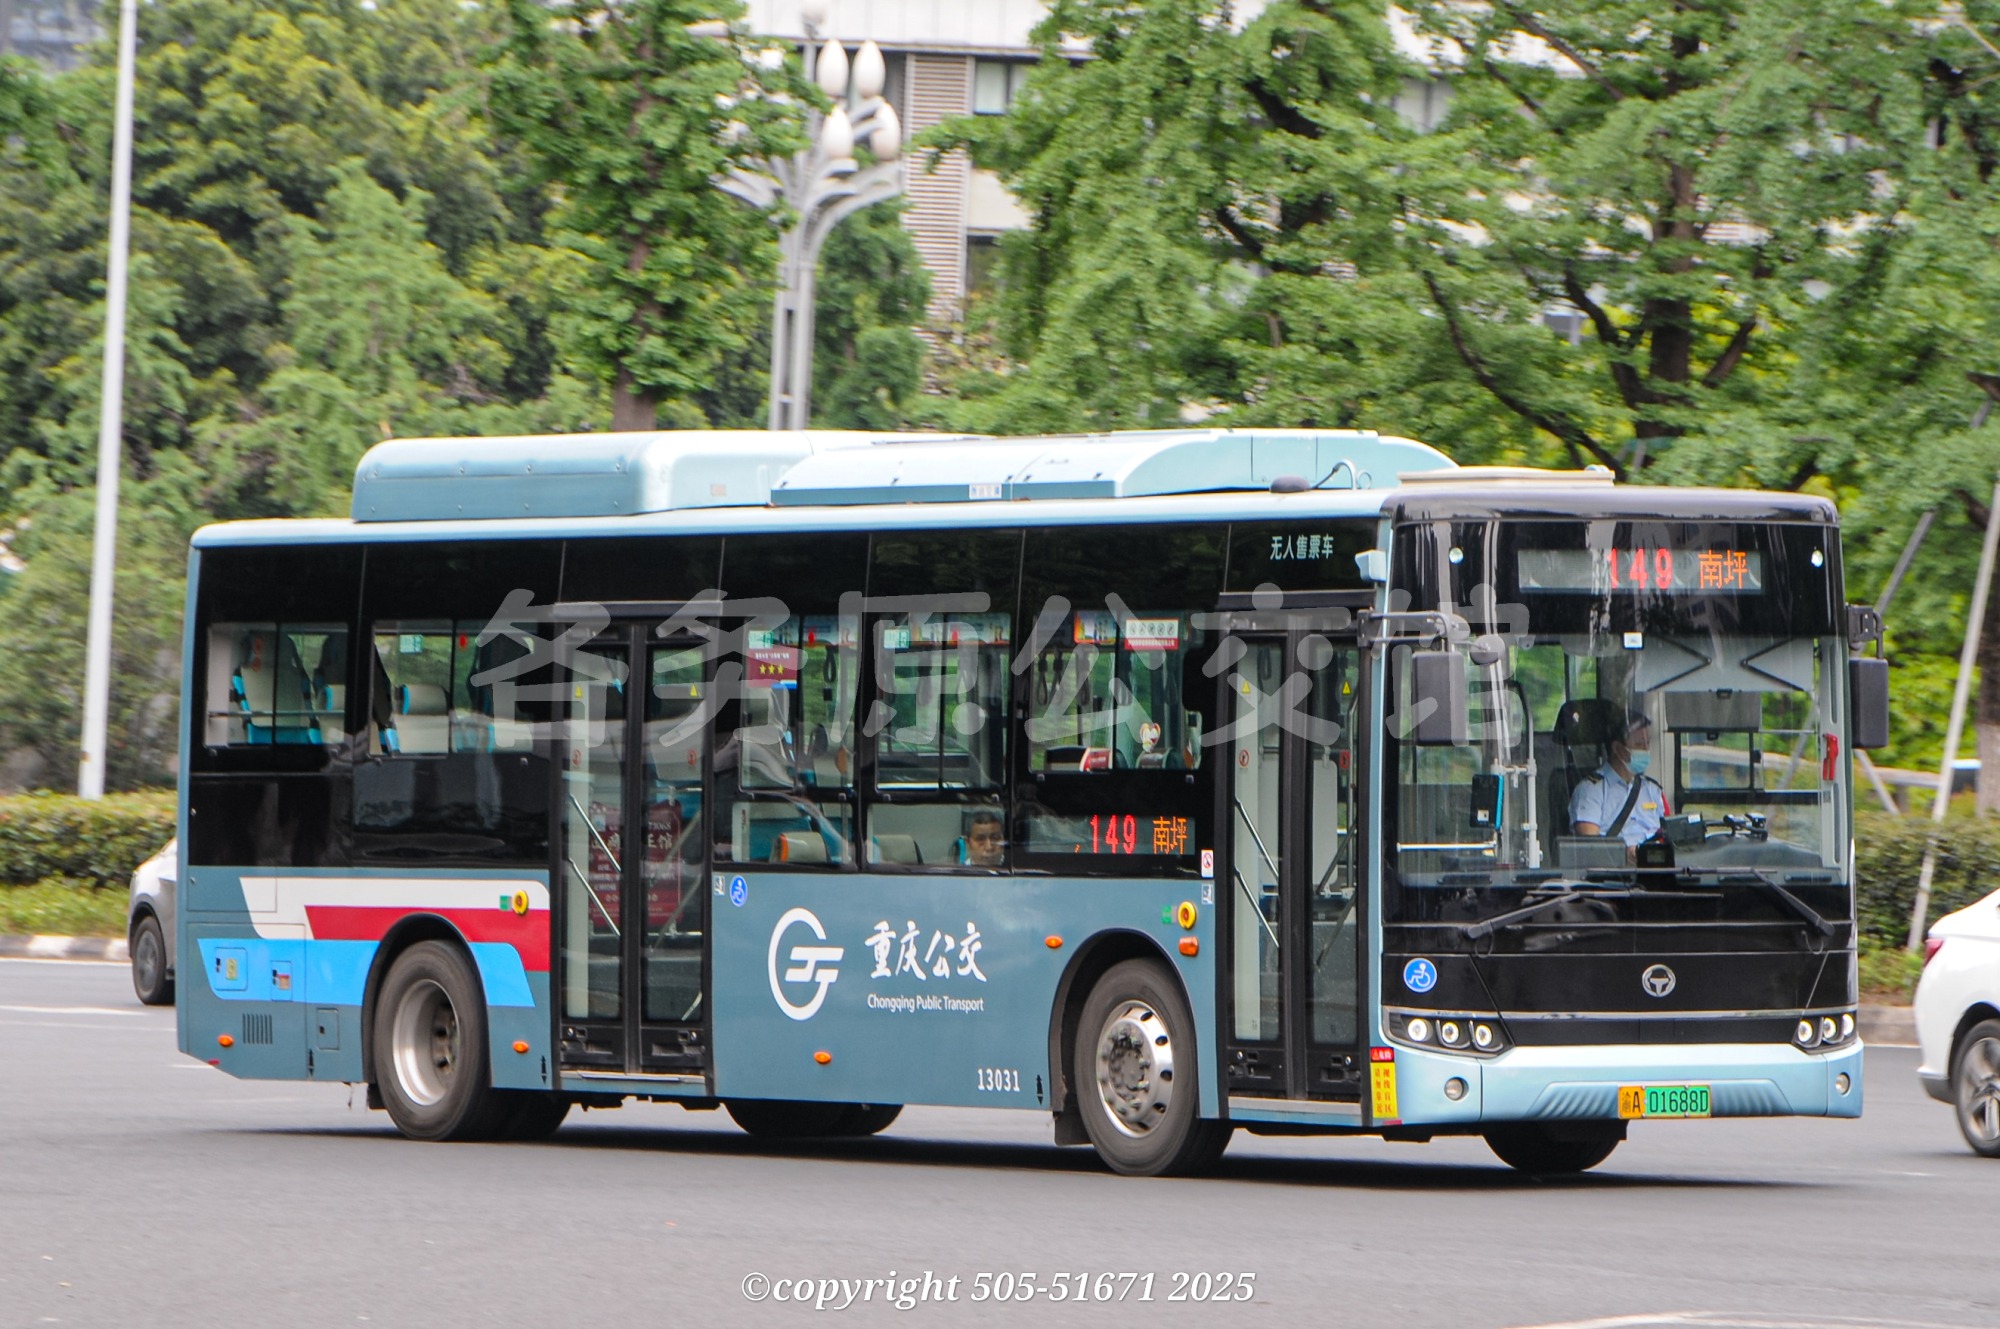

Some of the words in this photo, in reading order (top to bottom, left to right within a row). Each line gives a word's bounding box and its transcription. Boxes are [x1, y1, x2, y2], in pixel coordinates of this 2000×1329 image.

[1270, 534, 1334, 560] 无人售票车
[1607, 548, 1672, 589] 149
[1698, 550, 1748, 589] 南坪
[1090, 814, 1137, 854] 149
[1153, 816, 1188, 854] 南坪
[864, 920, 988, 982] 重庆公交
[867, 993, 915, 1013] Chongqing
[916, 995, 942, 1011] Public
[943, 996, 985, 1014] Transport
[977, 1068, 1020, 1093] 13031
